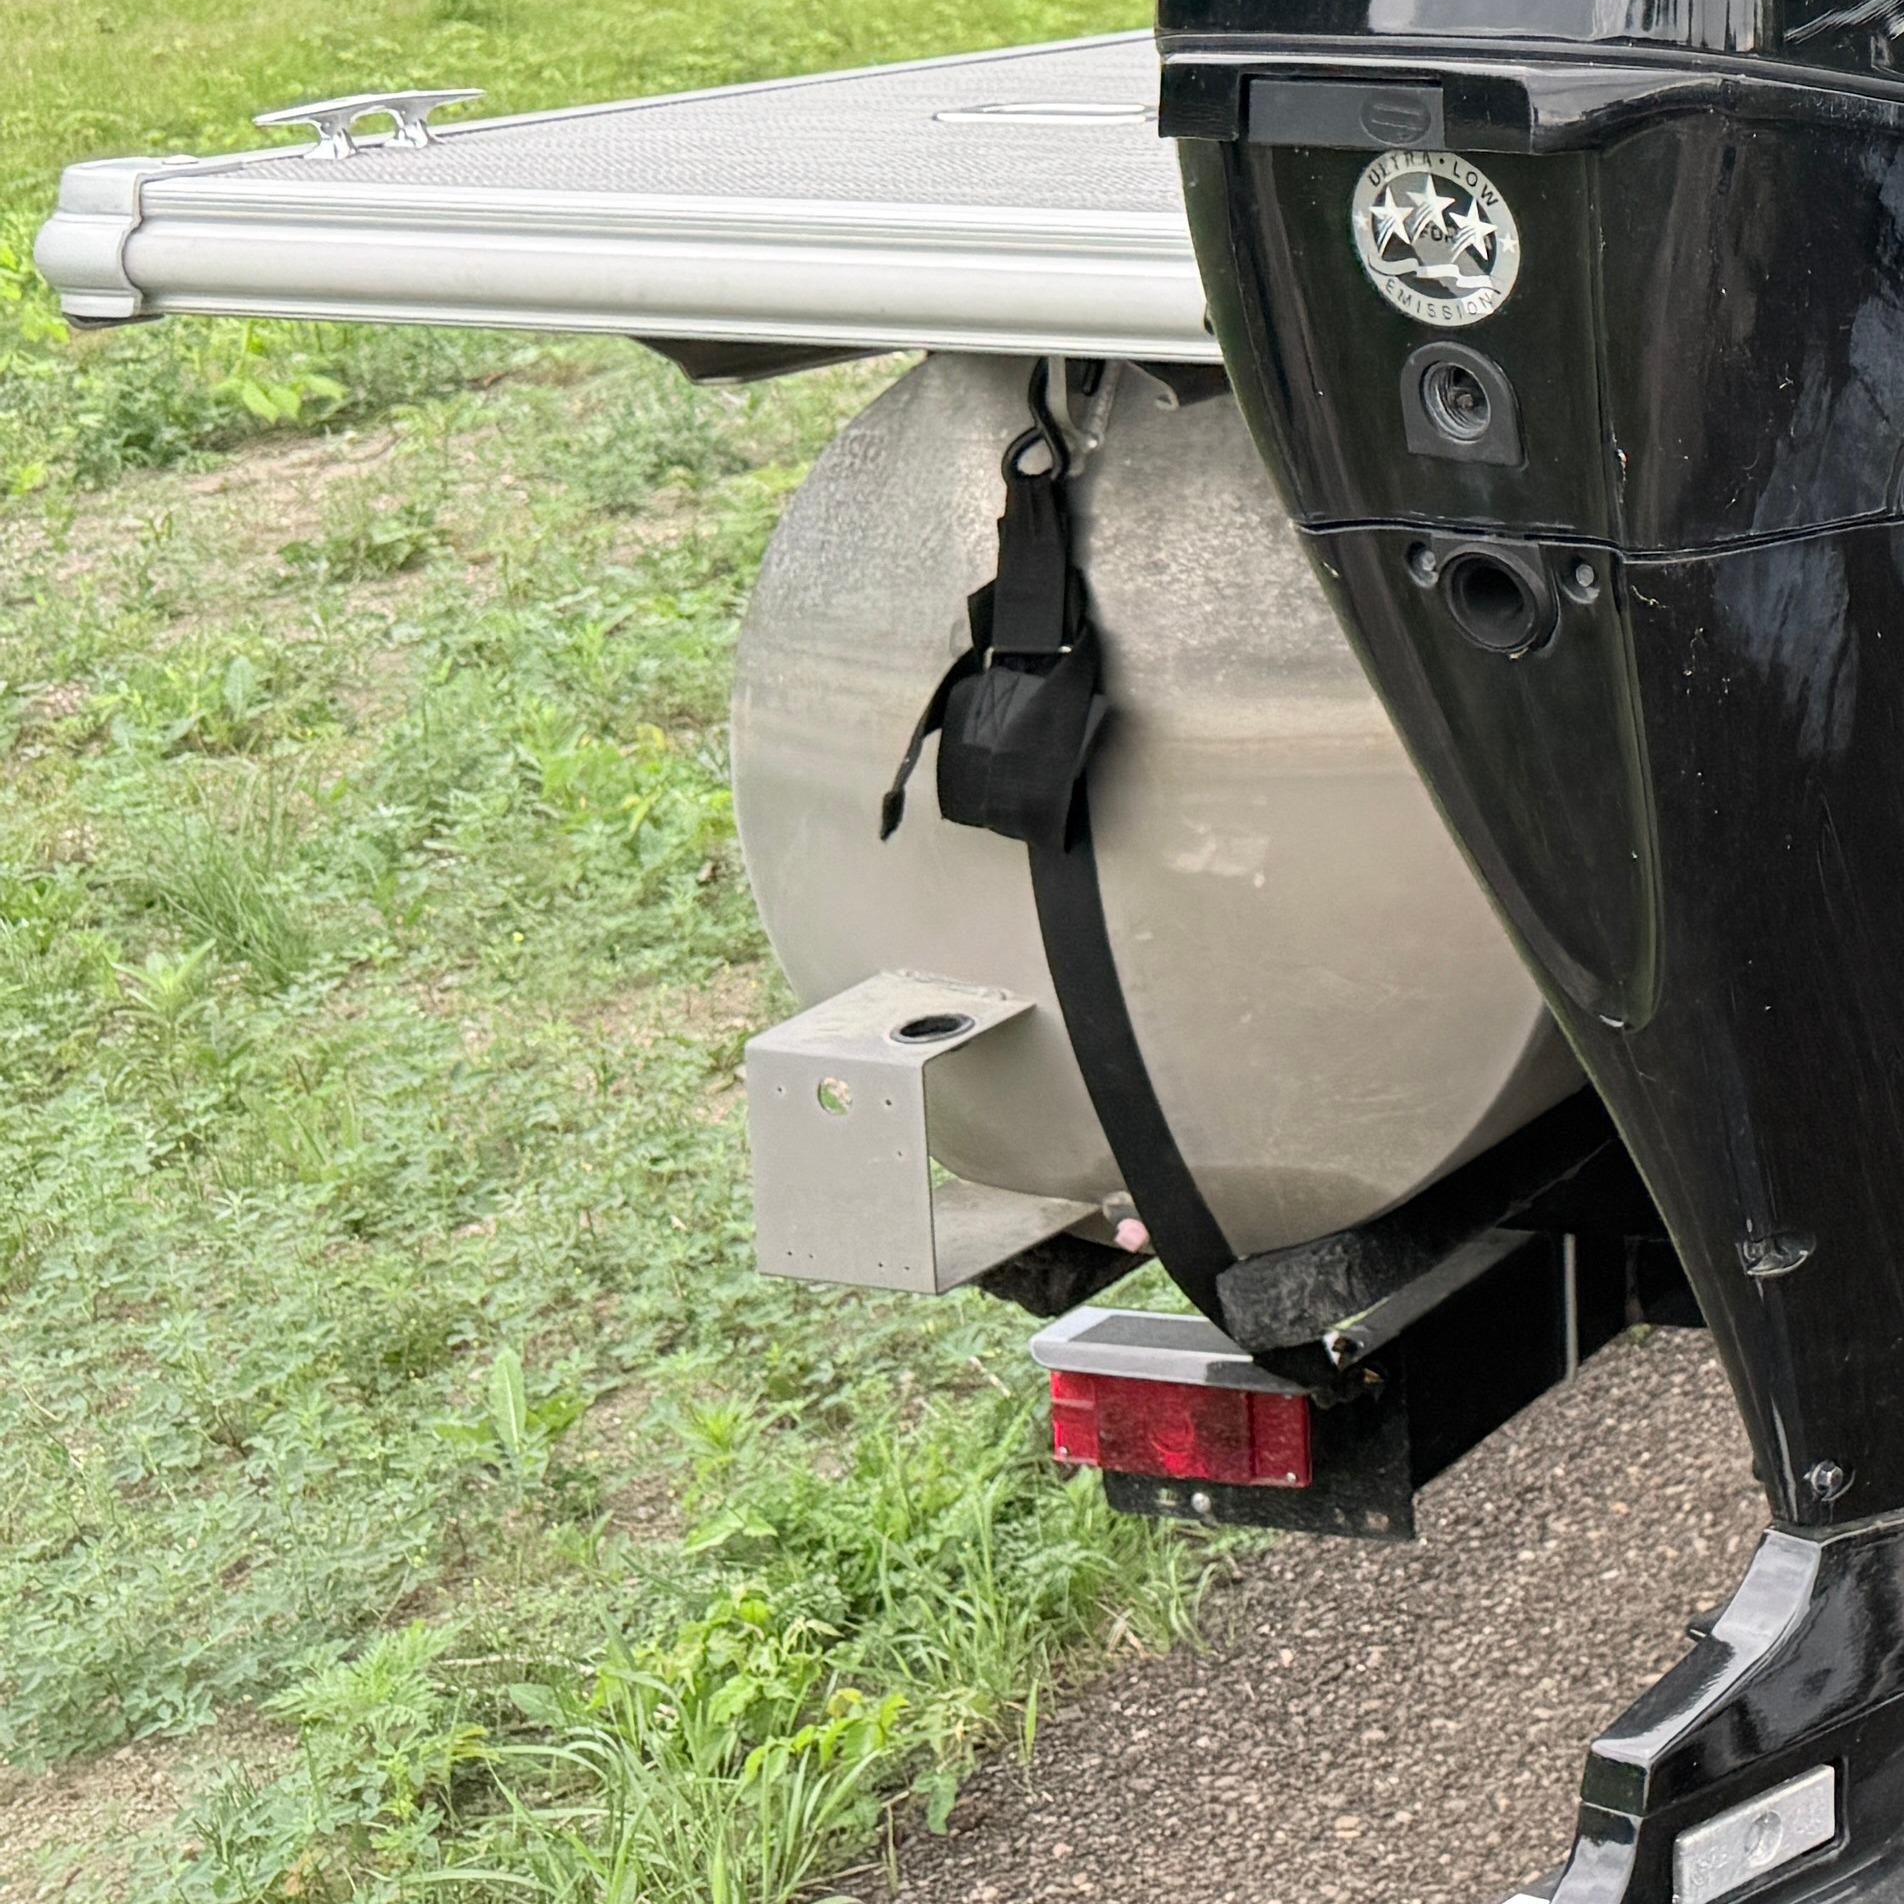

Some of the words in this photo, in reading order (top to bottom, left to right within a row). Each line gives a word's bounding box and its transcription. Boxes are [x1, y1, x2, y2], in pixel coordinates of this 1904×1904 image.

[1367, 150, 1433, 188] ULTRA
[1452, 159, 1500, 208] LOW
[1384, 277, 1496, 321] EMISSION
